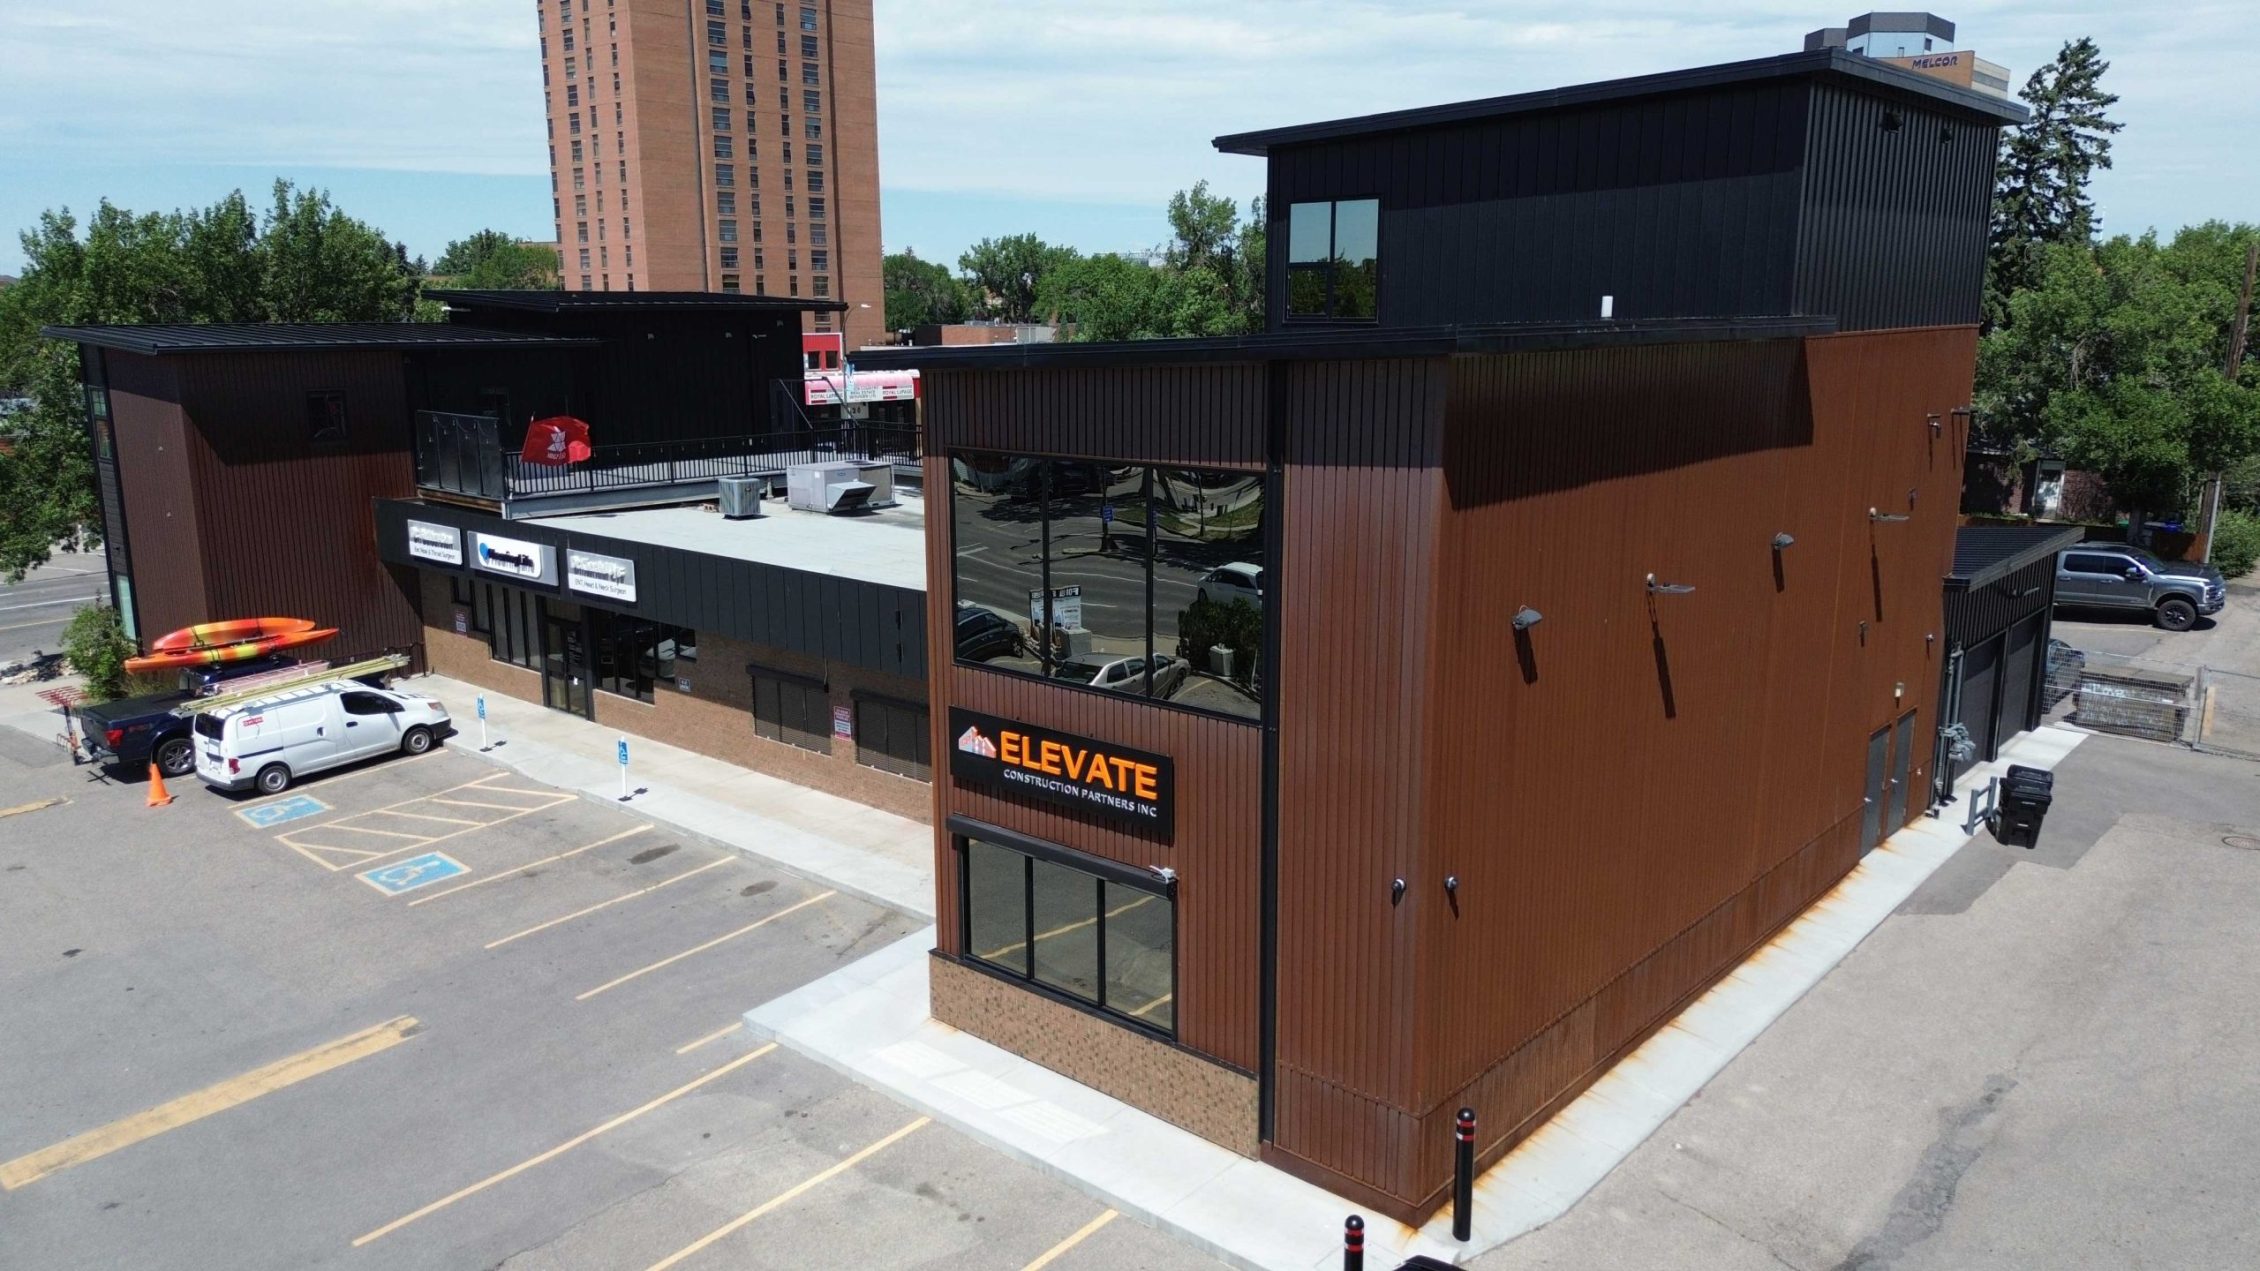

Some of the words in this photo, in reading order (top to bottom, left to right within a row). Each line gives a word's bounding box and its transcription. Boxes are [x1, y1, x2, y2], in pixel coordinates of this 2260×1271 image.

[1912, 55, 1958, 70] MELCOR
[1000, 730, 1158, 800] ELEVATE
[1003, 768, 1079, 798] CONSTRUCTION
[1081, 788, 1135, 812] PARTNERS
[1137, 803, 1157, 818] INC
